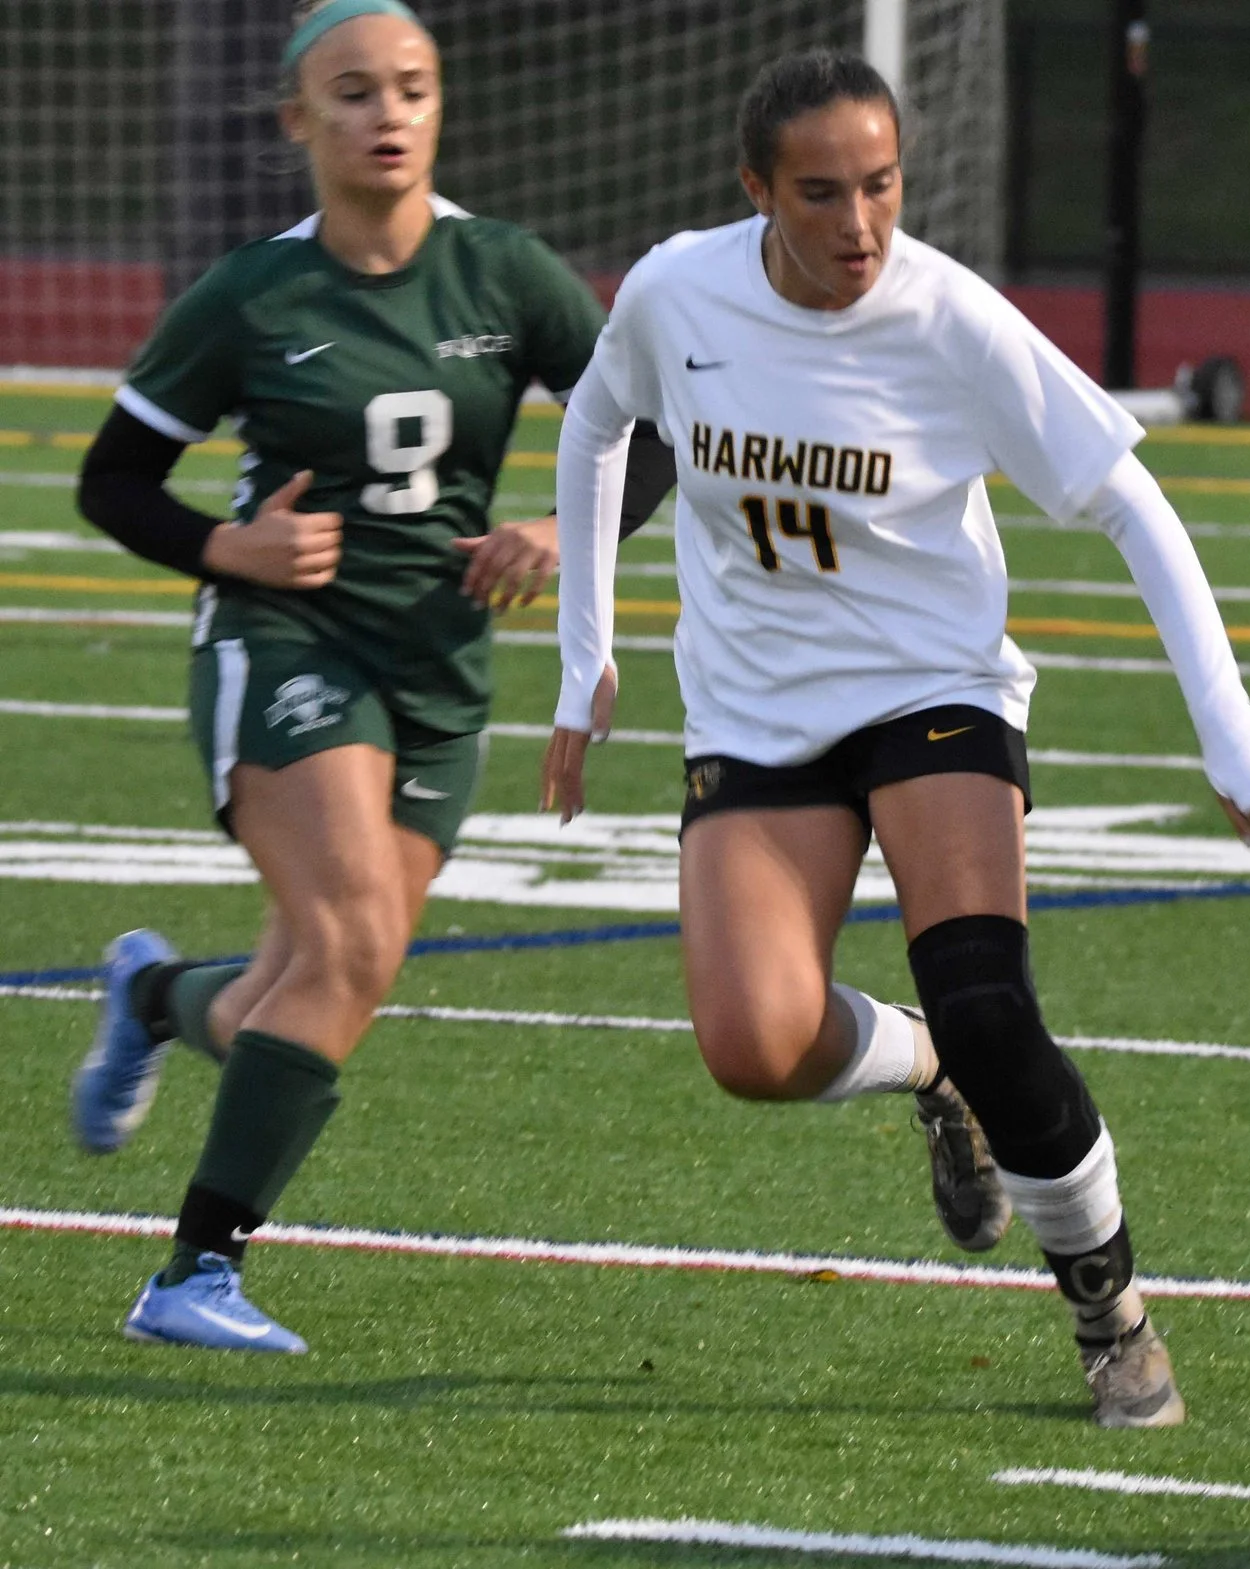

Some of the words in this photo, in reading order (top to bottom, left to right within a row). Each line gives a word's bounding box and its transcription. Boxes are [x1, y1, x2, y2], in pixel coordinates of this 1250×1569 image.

[360, 389, 454, 515] 9
[692, 421, 892, 496] HARWOOD
[739, 493, 840, 574] 14
[1070, 1254, 1114, 1302] C
